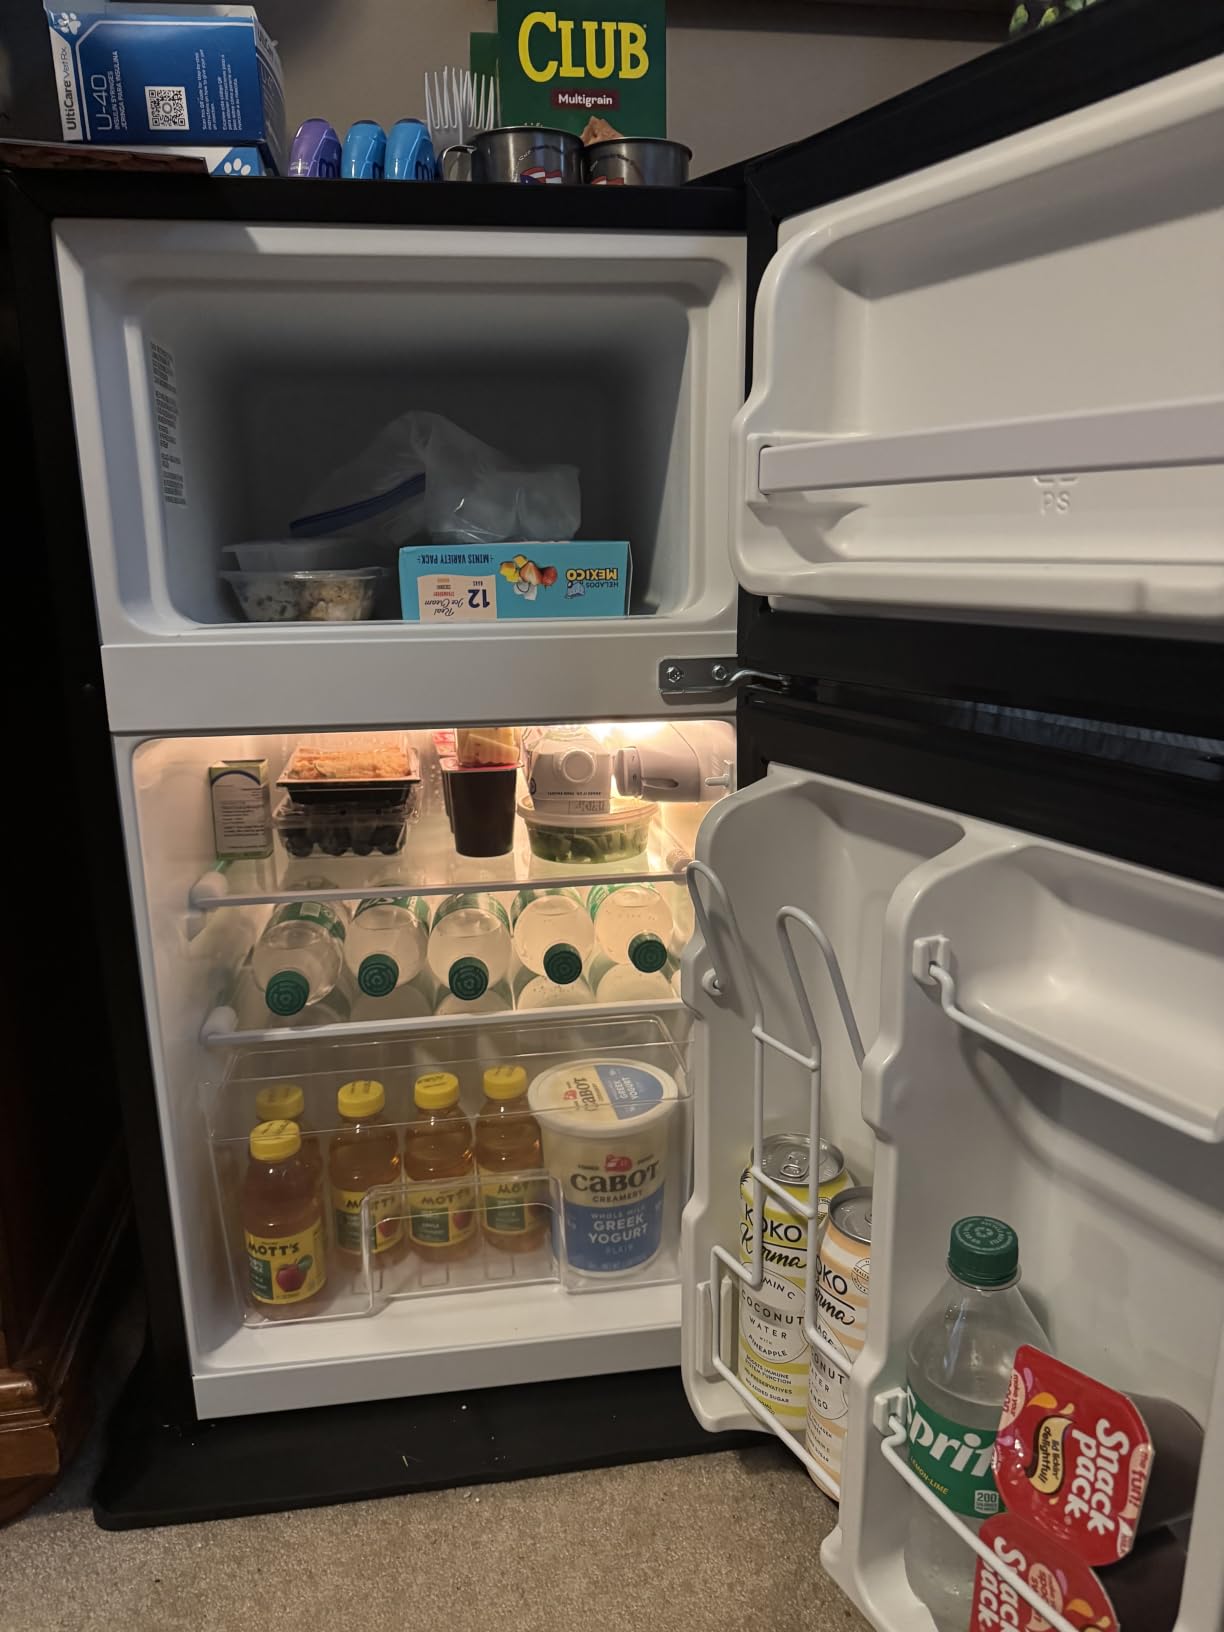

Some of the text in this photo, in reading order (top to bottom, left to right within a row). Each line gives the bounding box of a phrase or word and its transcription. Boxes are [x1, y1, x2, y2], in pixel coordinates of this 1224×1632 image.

[518, 11, 649, 82] CLUB
[108, 70, 117, 103] SYRINGES
[64, 80, 77, 131] UltiCare
[90, 74, 113, 131] U-40
[558, 93, 613, 107] Multigrain
[421, 554, 490, 565] MINIS VARIETY PACK
[566, 568, 618, 582] MEXICO
[585, 581, 619, 589] HELADOS
[424, 597, 464, 609] Ice Cream
[468, 589, 490, 609] 12
[434, 607, 455, 617] Real
[592, 1190, 644, 1203] CREAMERY
[593, 1213, 644, 1231] GREEK
[588, 1223, 649, 1244] YOGURT
[248, 1241, 300, 1257] MOTT'S
[740, 1222, 808, 1269] Krma
[815, 1254, 848, 1295] OKO
[742, 1289, 805, 1325] COCONUT
[749, 1315, 787, 1339] WATER
[748, 1334, 788, 1357] PINEAPPLE
[751, 1373, 793, 1394] PRESERVATIVES
[769, 1394, 789, 1403] SUGAR
[1051, 1439, 1060, 1452] lid
[1087, 1418, 1131, 1536] Snack
[976, 1491, 997, 1503] 200
[978, 1560, 1000, 1628] ack
[993, 1535, 1027, 1632] Sack
